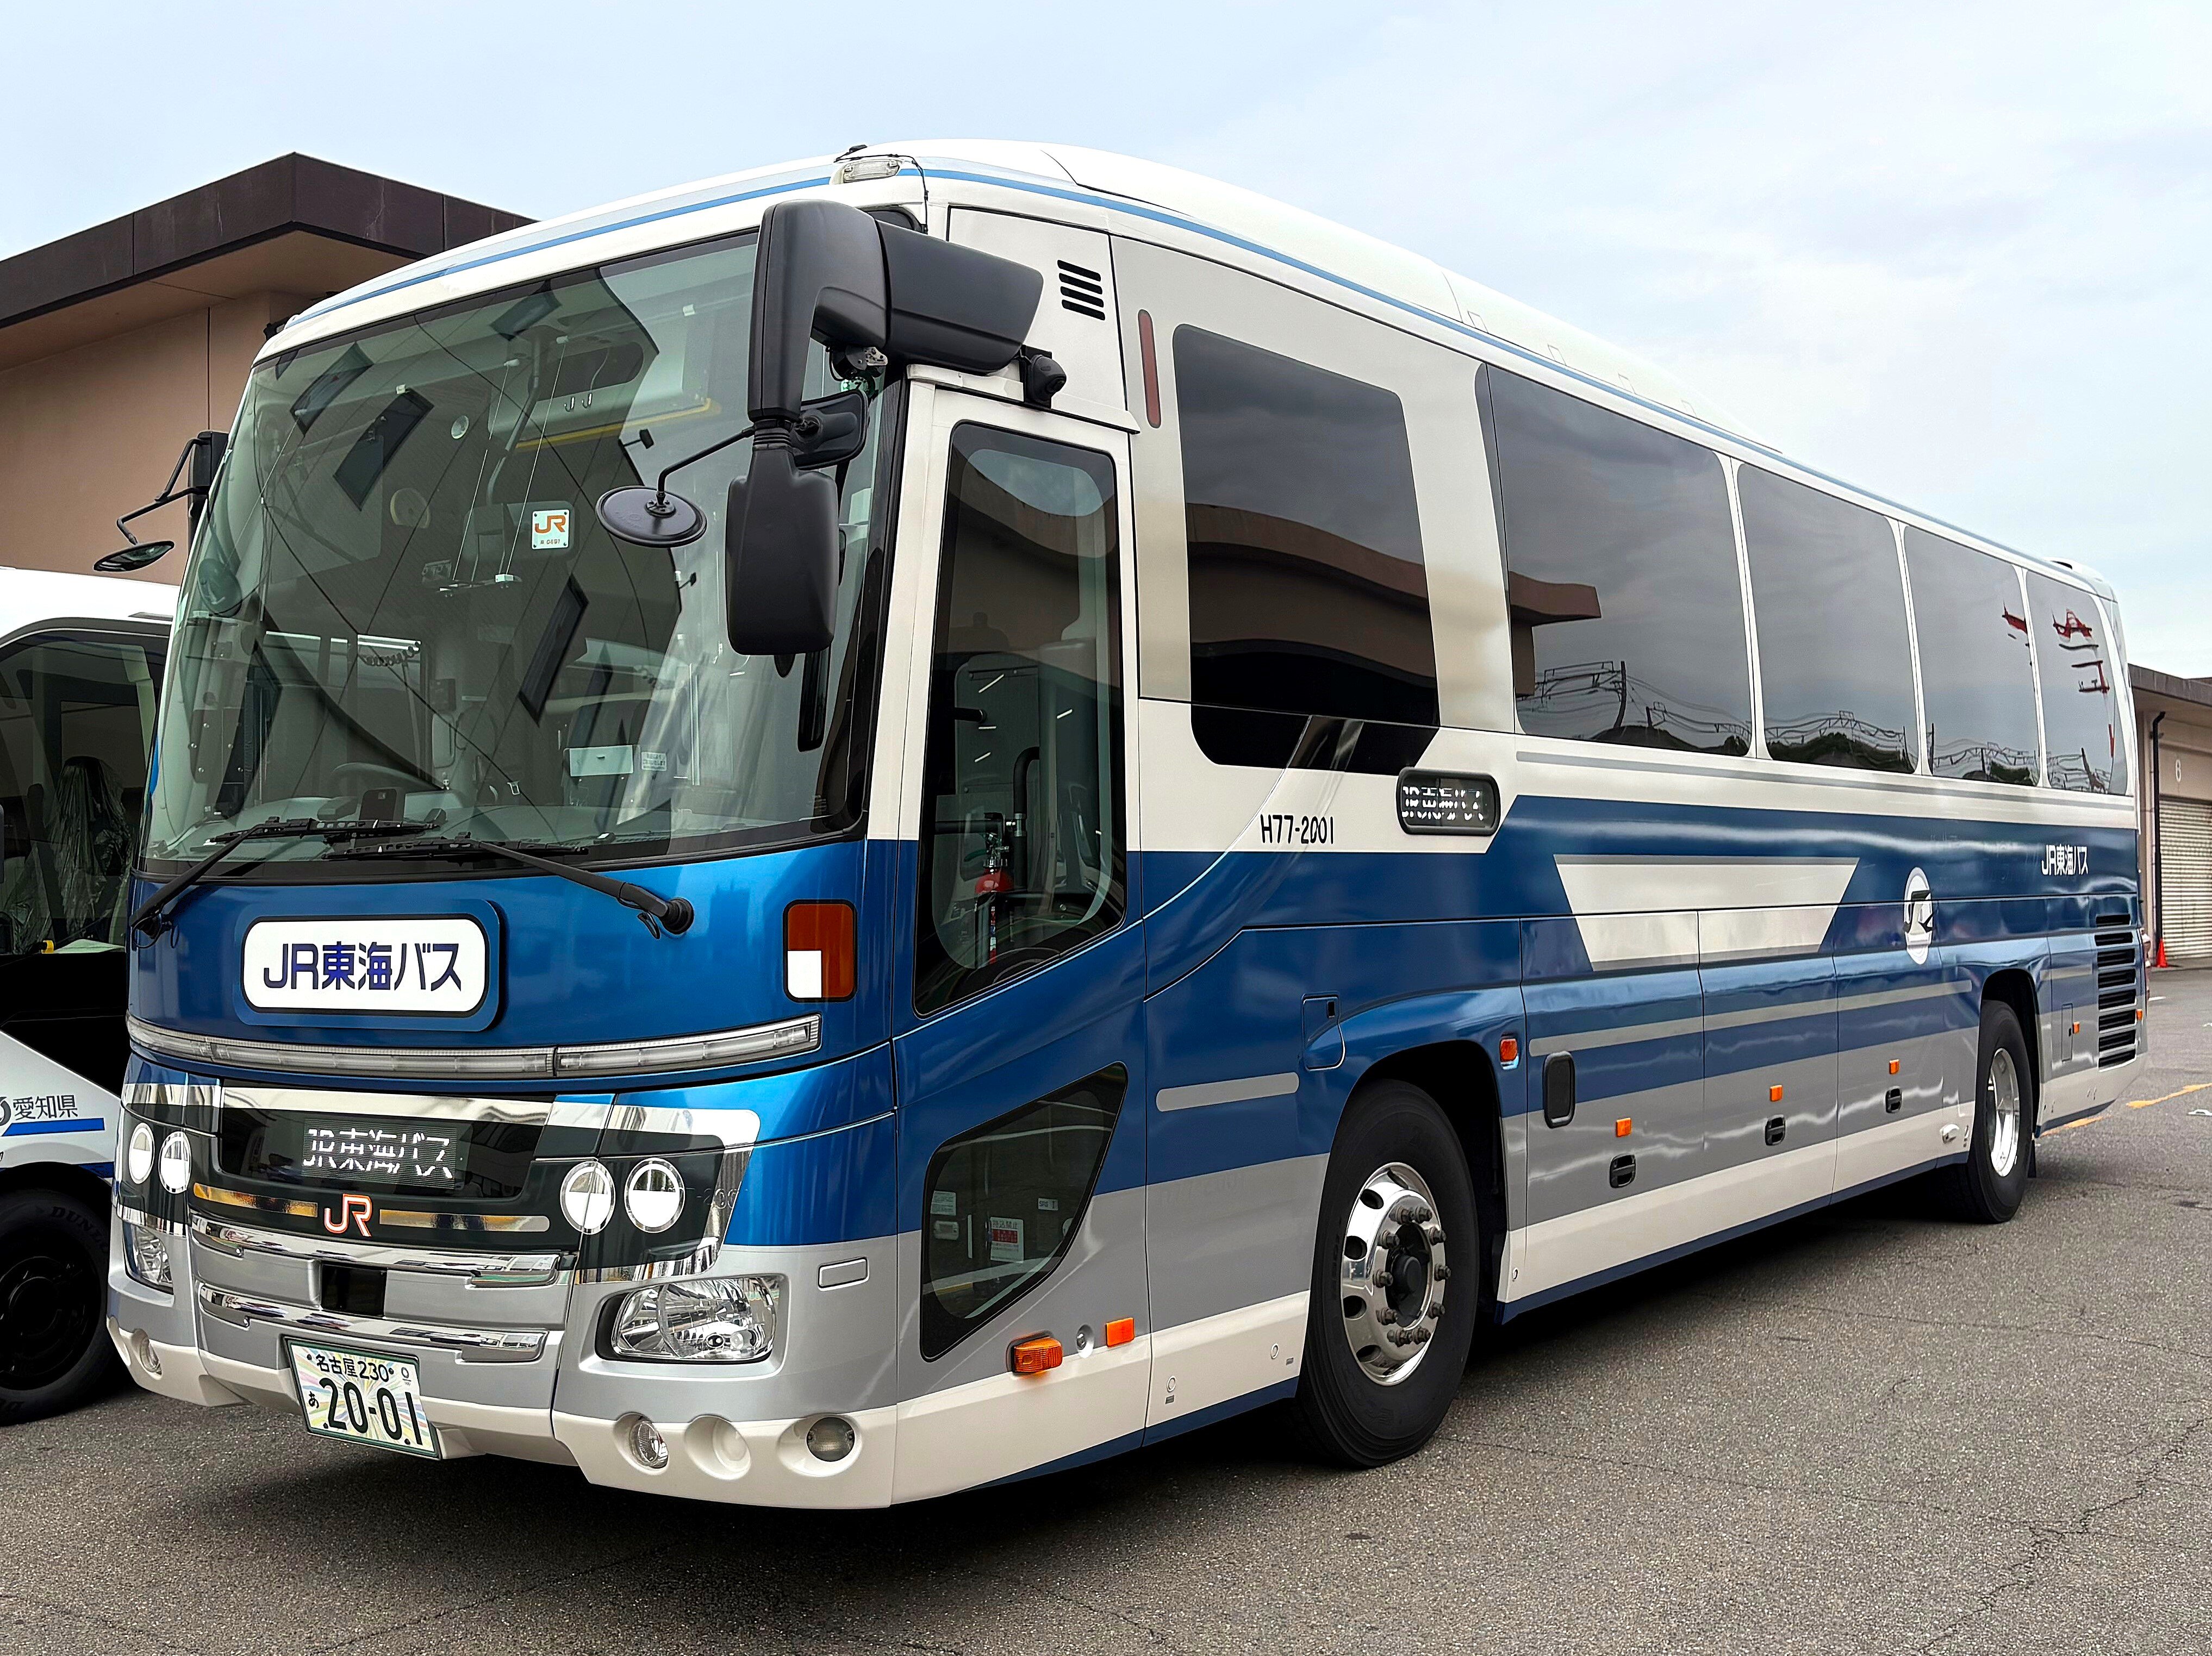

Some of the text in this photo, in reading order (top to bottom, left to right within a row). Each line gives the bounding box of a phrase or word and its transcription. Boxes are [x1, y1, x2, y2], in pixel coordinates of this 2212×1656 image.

[535, 515, 566, 534] JR
[2176, 759, 2182, 782] 8
[1260, 814, 1334, 845] H77-2001
[2041, 843, 2089, 876] JR東海バス
[264, 941, 462, 991] JR東海バス
[13, 1095, 78, 1121] 愛知県
[324, 1193, 373, 1238] JR
[308, 1377, 423, 1446] あ 20-01
